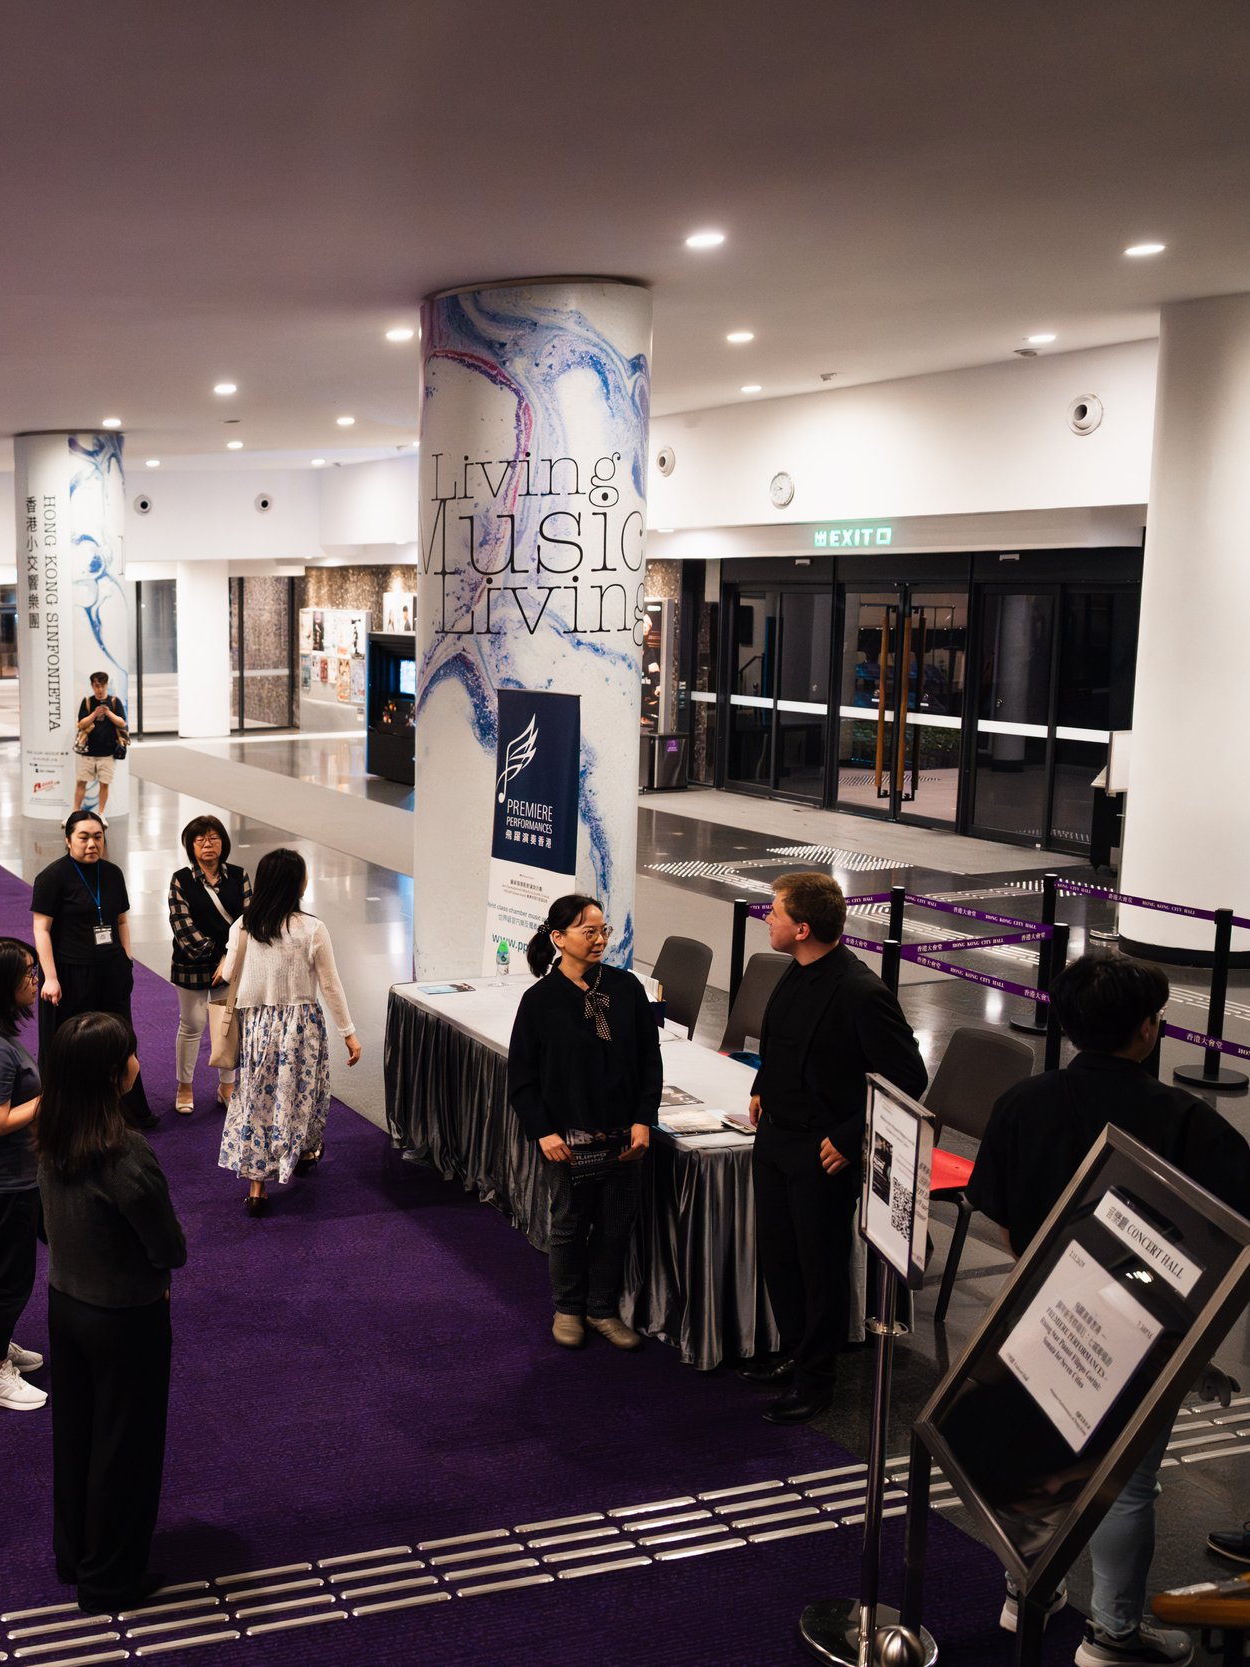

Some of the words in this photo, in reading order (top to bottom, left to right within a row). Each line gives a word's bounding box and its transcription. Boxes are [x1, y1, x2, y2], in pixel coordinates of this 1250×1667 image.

[431, 452, 621, 507] Living
[43, 496, 57, 546] HONG
[418, 499, 644, 576] Music
[829, 528, 874, 547] EXIT
[25, 496, 40, 629] 香港小交響樂團
[45, 555, 59, 605] KONG
[435, 574, 644, 647] Living
[46, 612, 61, 732] SINFONIETTA
[506, 816, 553, 834] PERFORMANCES
[507, 799, 554, 822] PREMIERE
[985, 914, 999, 922] HONG
[917, 943, 943, 953] 香港大會堂
[950, 967, 964, 976] HONG
[965, 972, 979, 981] KONG
[980, 976, 991, 984] CITY
[992, 980, 1005, 988] HALL
[1186, 1033, 1223, 1050] 香港大會堂
[1127, 1224, 1162, 1259] CONCERT
[1161, 1254, 1184, 1279] HALL
